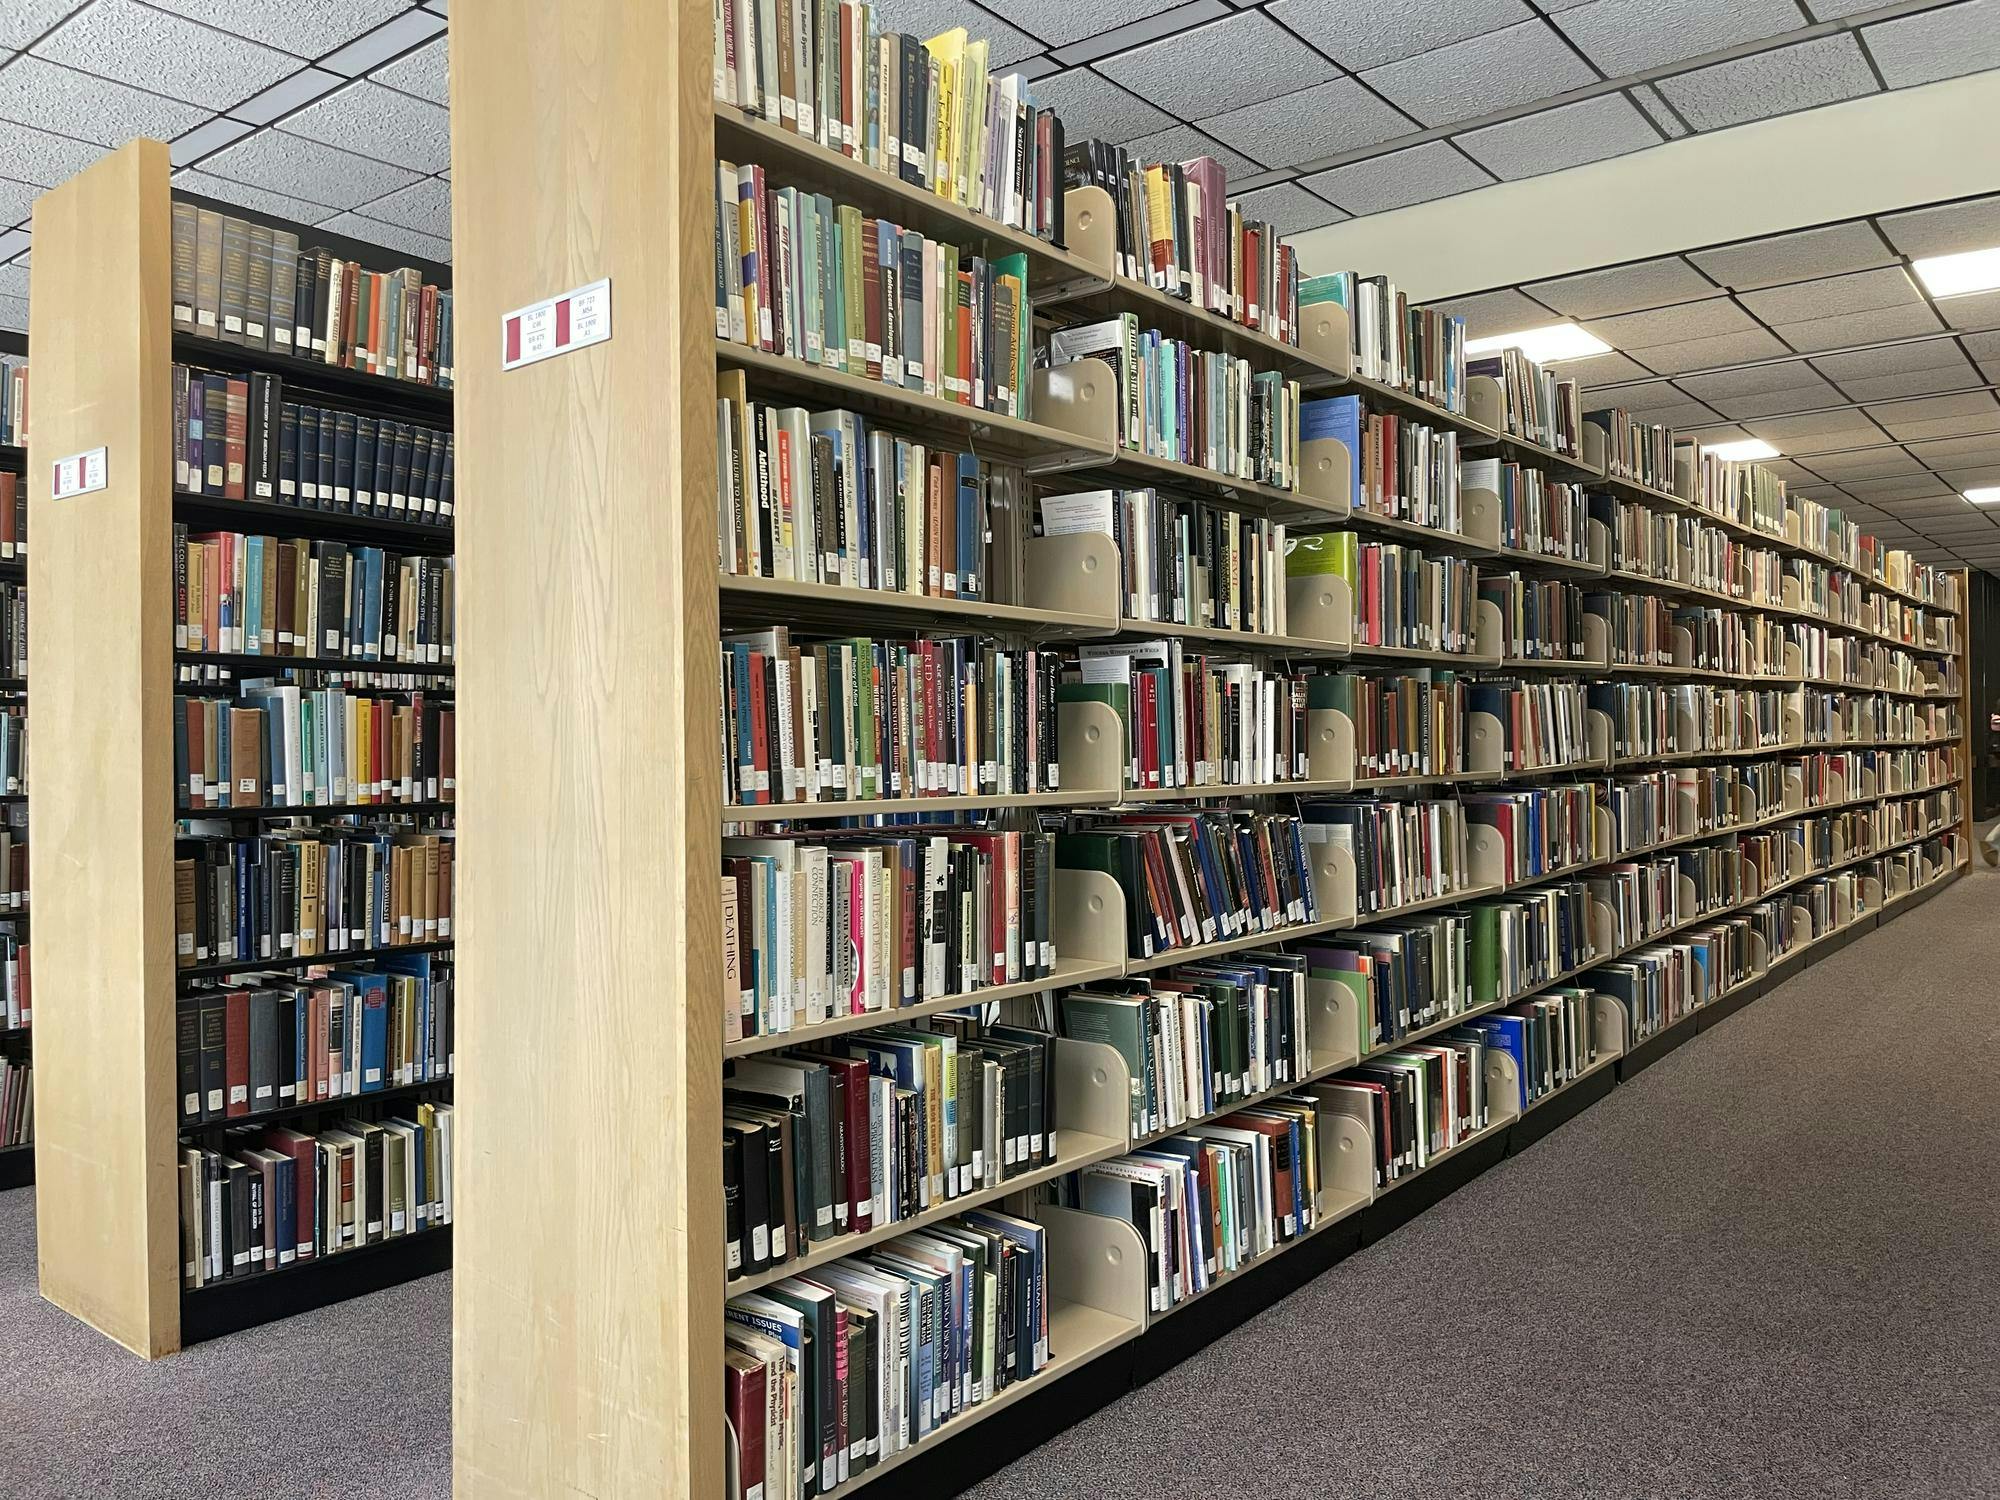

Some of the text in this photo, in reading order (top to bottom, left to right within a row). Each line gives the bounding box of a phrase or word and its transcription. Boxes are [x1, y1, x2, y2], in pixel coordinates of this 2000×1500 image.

[716, 243, 725, 289] CHILDHOOD
[732, 449, 742, 533] FAILURE TO LAUNCH
[758, 449, 770, 509] Adulthood
[847, 480, 853, 488] of
[839, 510, 845, 520] TO
[846, 489, 854, 509] Aging
[840, 521, 845, 531] BE
[179, 534, 187, 621] THE COLOR OF CHRIST
[853, 680, 858, 688] of
[925, 654, 933, 682] RED
[1277, 850, 1289, 889] MAGIC
[366, 870, 374, 931] PUBLIC VIRTUE
[742, 879, 751, 906] Death
[811, 866, 819, 927] CONNECTION
[872, 893, 881, 918] LIFE
[725, 905, 737, 980] DEATHING
[872, 932, 881, 977] DEATH
[1147, 1058, 1155, 1090] Quest
[877, 1114, 885, 1185] DICTIONARY OF
[252, 1201, 258, 1209] OF
[752, 1317, 782, 1333] ISSUES
[900, 1291, 911, 1362] DYING TO LIVE
[943, 1281, 952, 1360] PARTING VISIONS
[769, 1393, 778, 1427] Physicist
[841, 1399, 849, 1428] Reality
